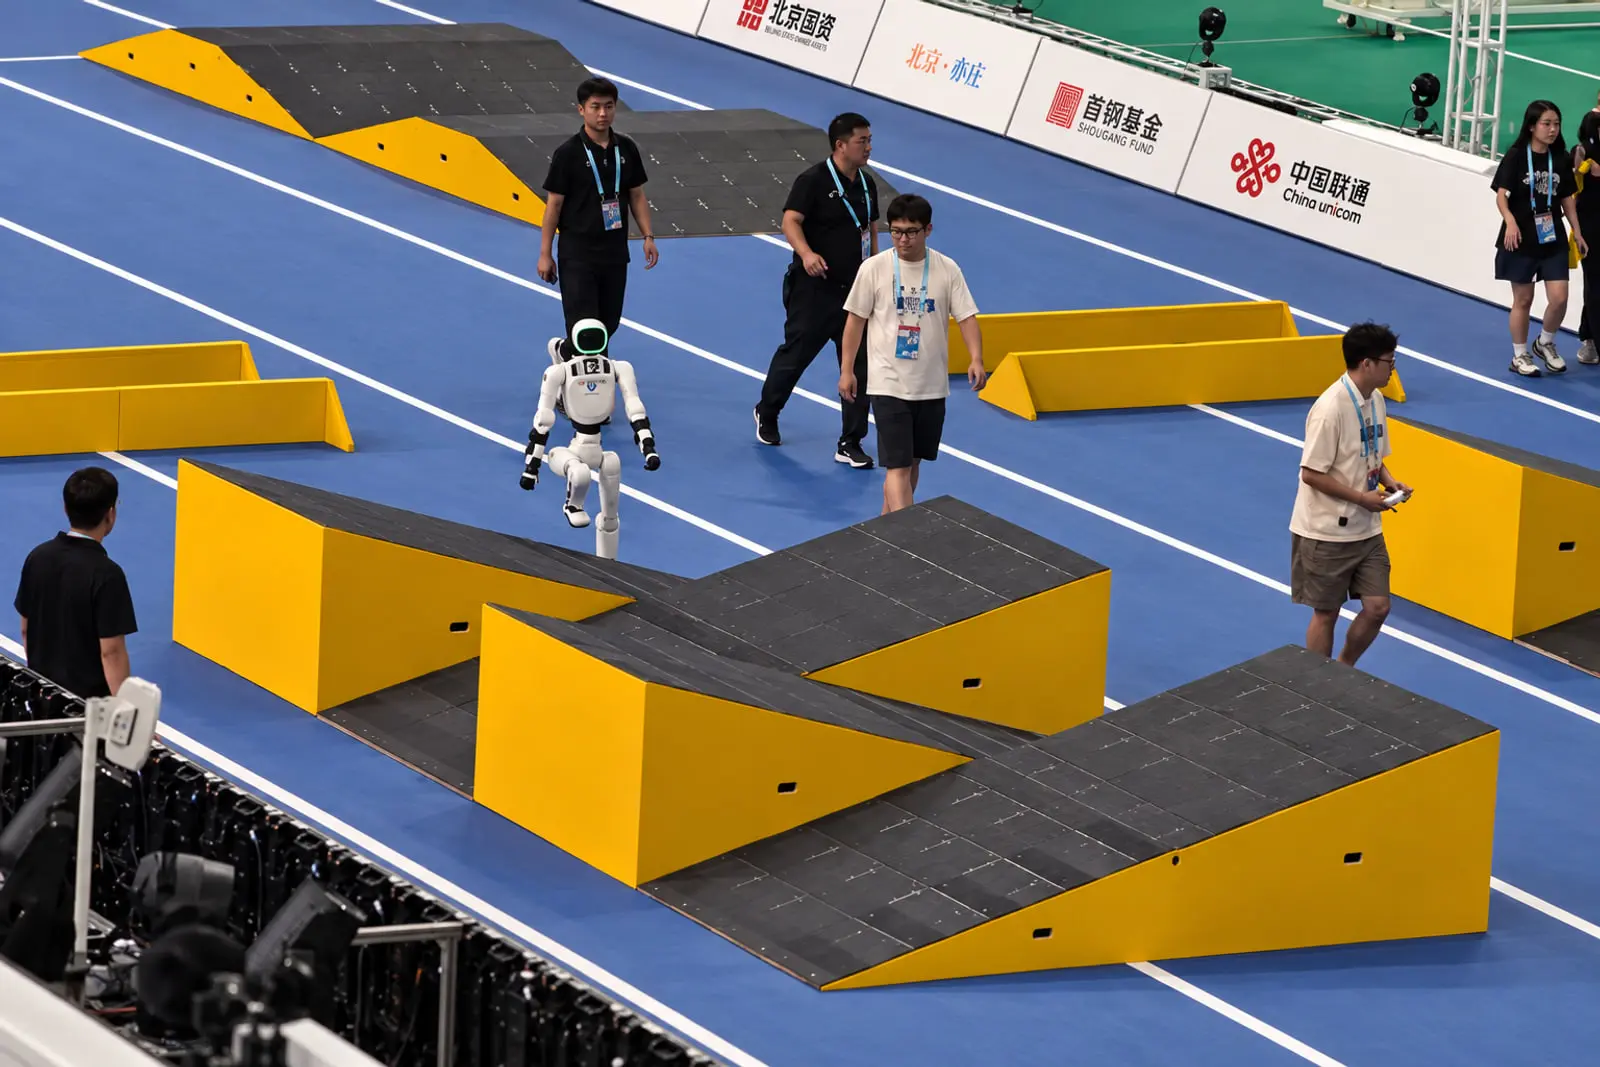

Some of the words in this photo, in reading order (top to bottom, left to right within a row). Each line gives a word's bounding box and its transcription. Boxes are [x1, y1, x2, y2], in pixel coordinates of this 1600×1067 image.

[769, 0, 836, 41] 北京国资
[1083, 93, 1162, 141] 首钢基金
[1077, 122, 1128, 146] SHOUGANG
[1129, 139, 1154, 155] FUND
[1290, 160, 1371, 207] 中国联通
[1283, 188, 1316, 210] China
[1318, 202, 1361, 224] unicom
